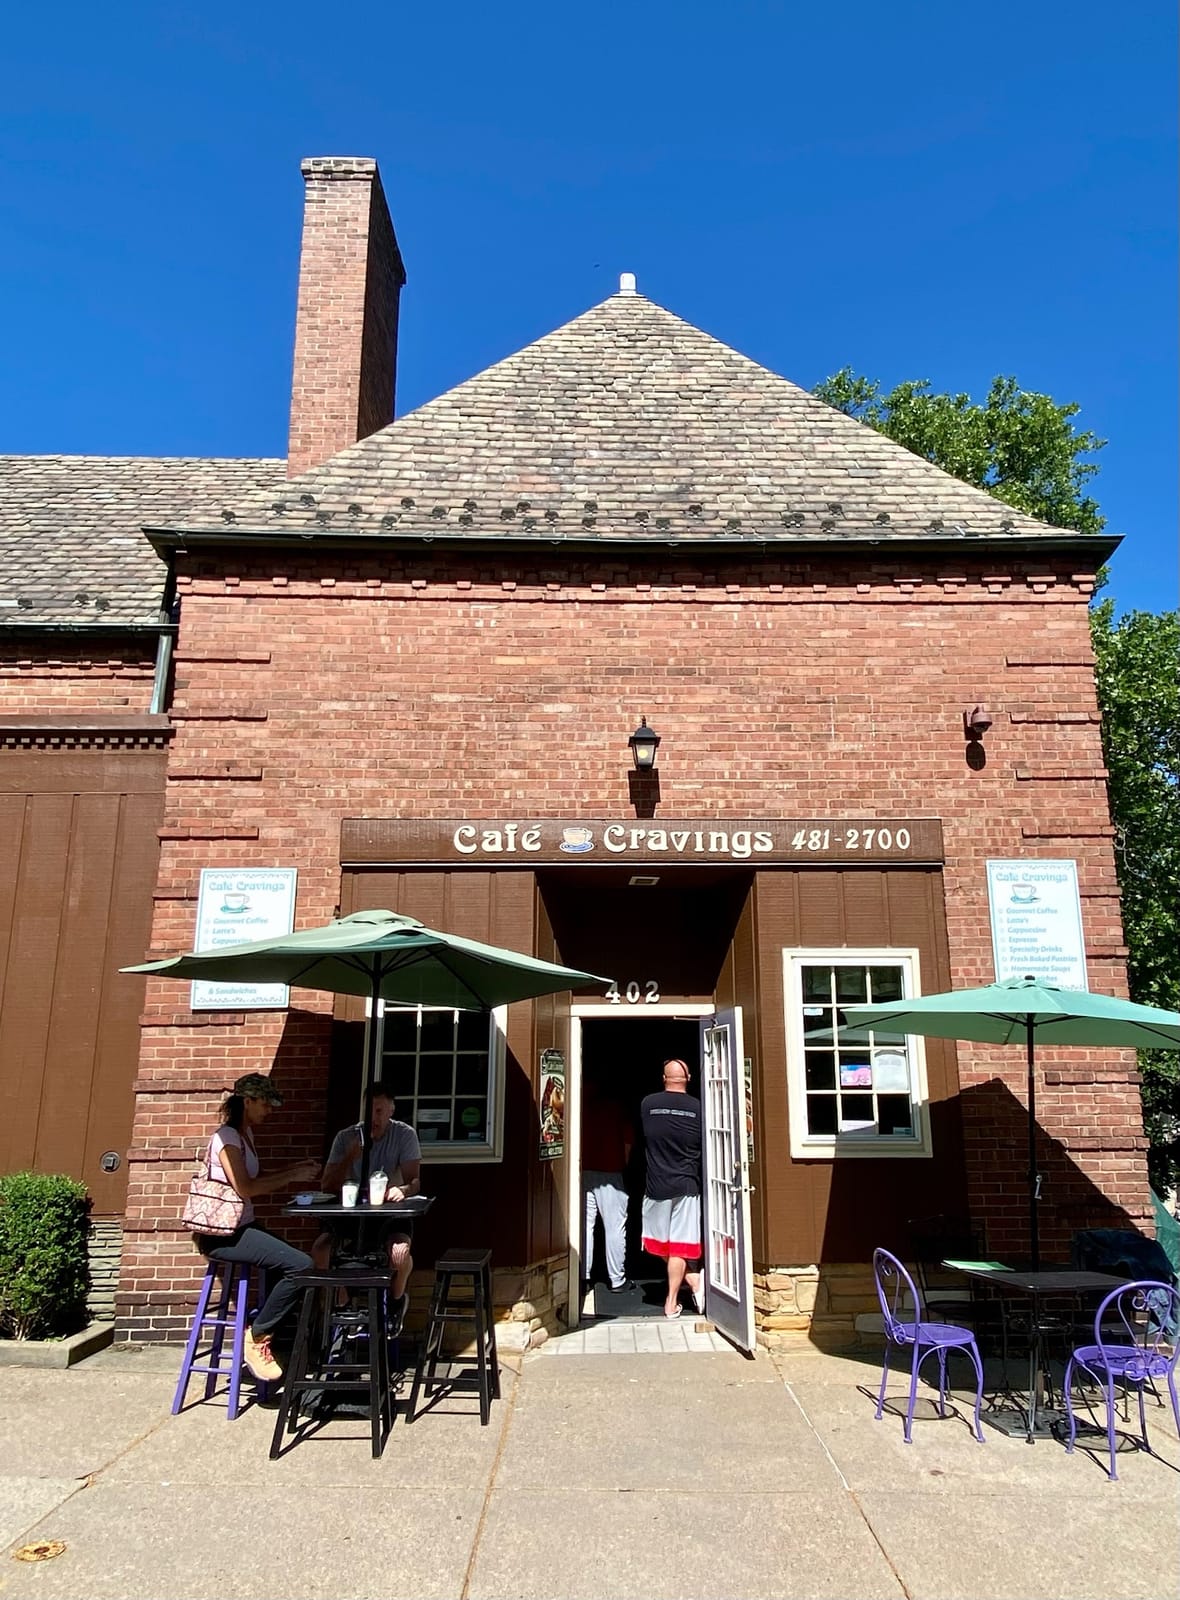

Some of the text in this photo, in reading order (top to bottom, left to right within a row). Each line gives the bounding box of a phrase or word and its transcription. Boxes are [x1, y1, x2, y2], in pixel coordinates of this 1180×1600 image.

[453, 823, 911, 858] Café Cravings 481-2700
[1022, 872, 1068, 883] Cravings
[236, 881, 286, 892] Cravings
[605, 981, 660, 1003] 402
